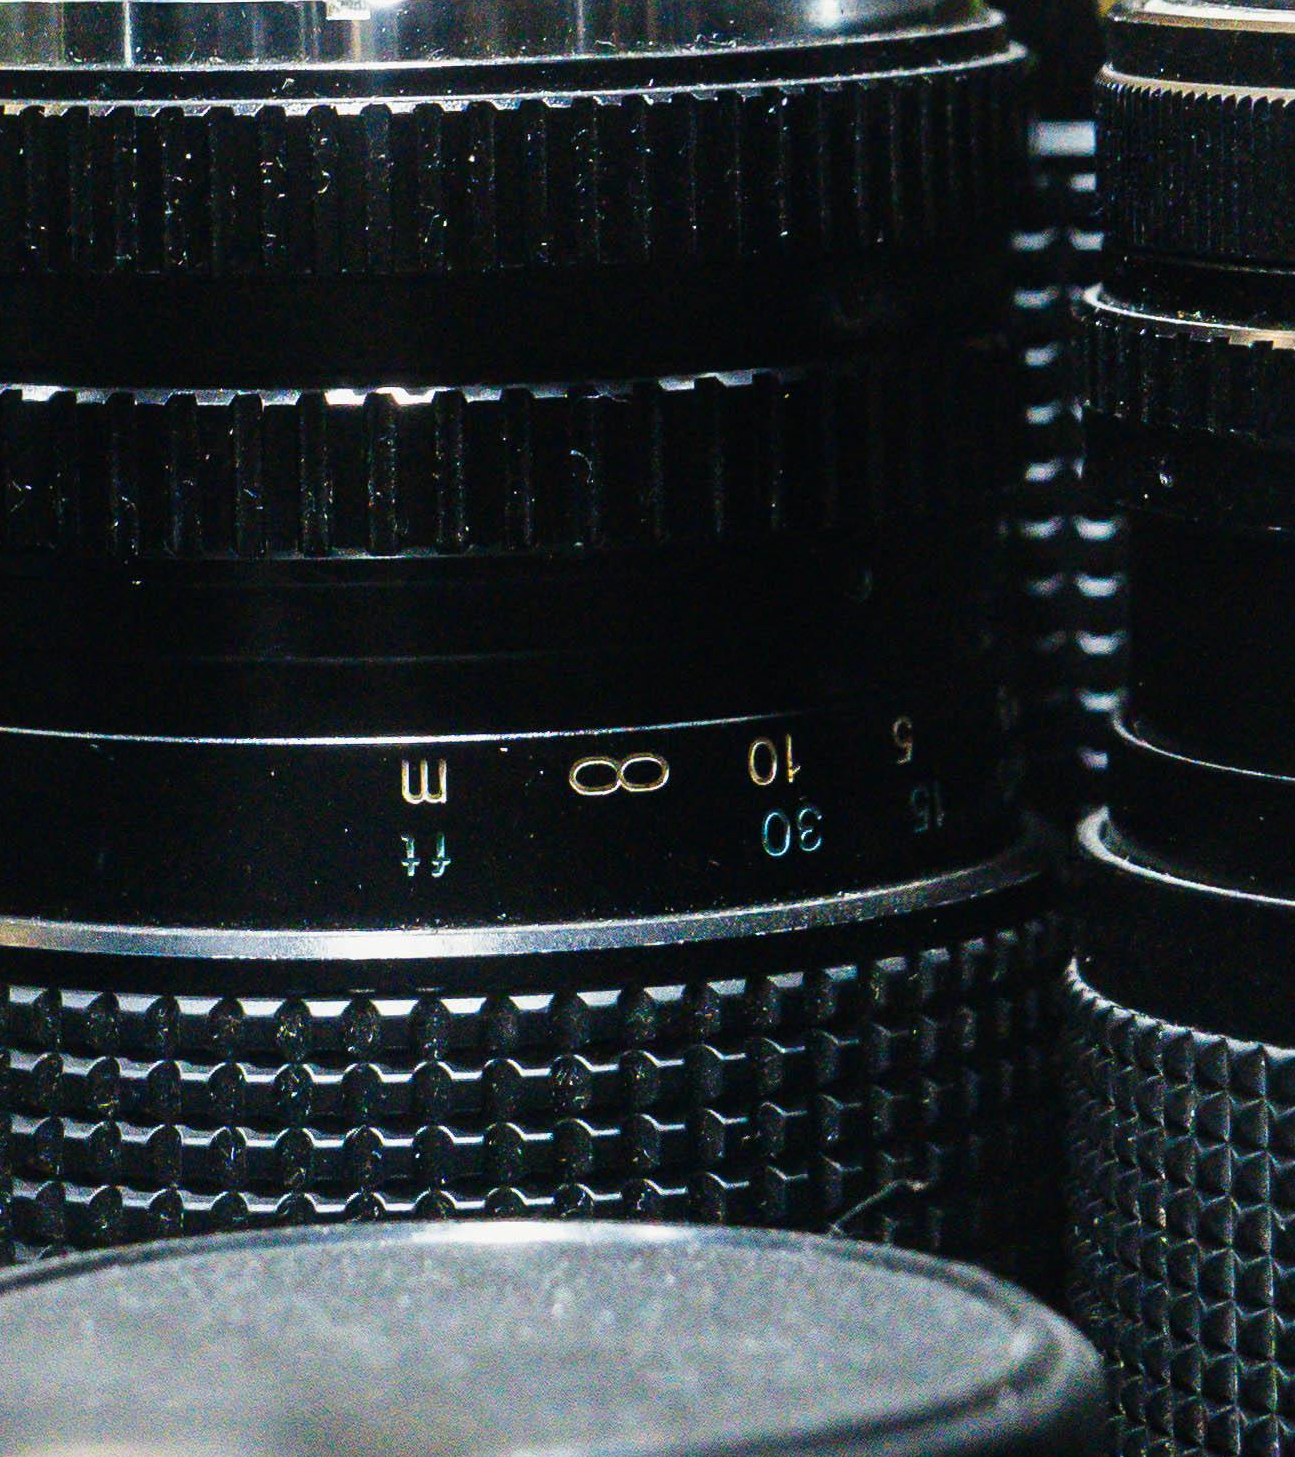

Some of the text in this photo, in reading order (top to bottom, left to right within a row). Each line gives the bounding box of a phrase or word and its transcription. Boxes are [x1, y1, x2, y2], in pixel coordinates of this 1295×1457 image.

[747, 733, 802, 787] 10
[890, 715, 915, 766] 5
[400, 757, 449, 806] m
[908, 780, 947, 835] 15
[760, 802, 824, 858] 30
